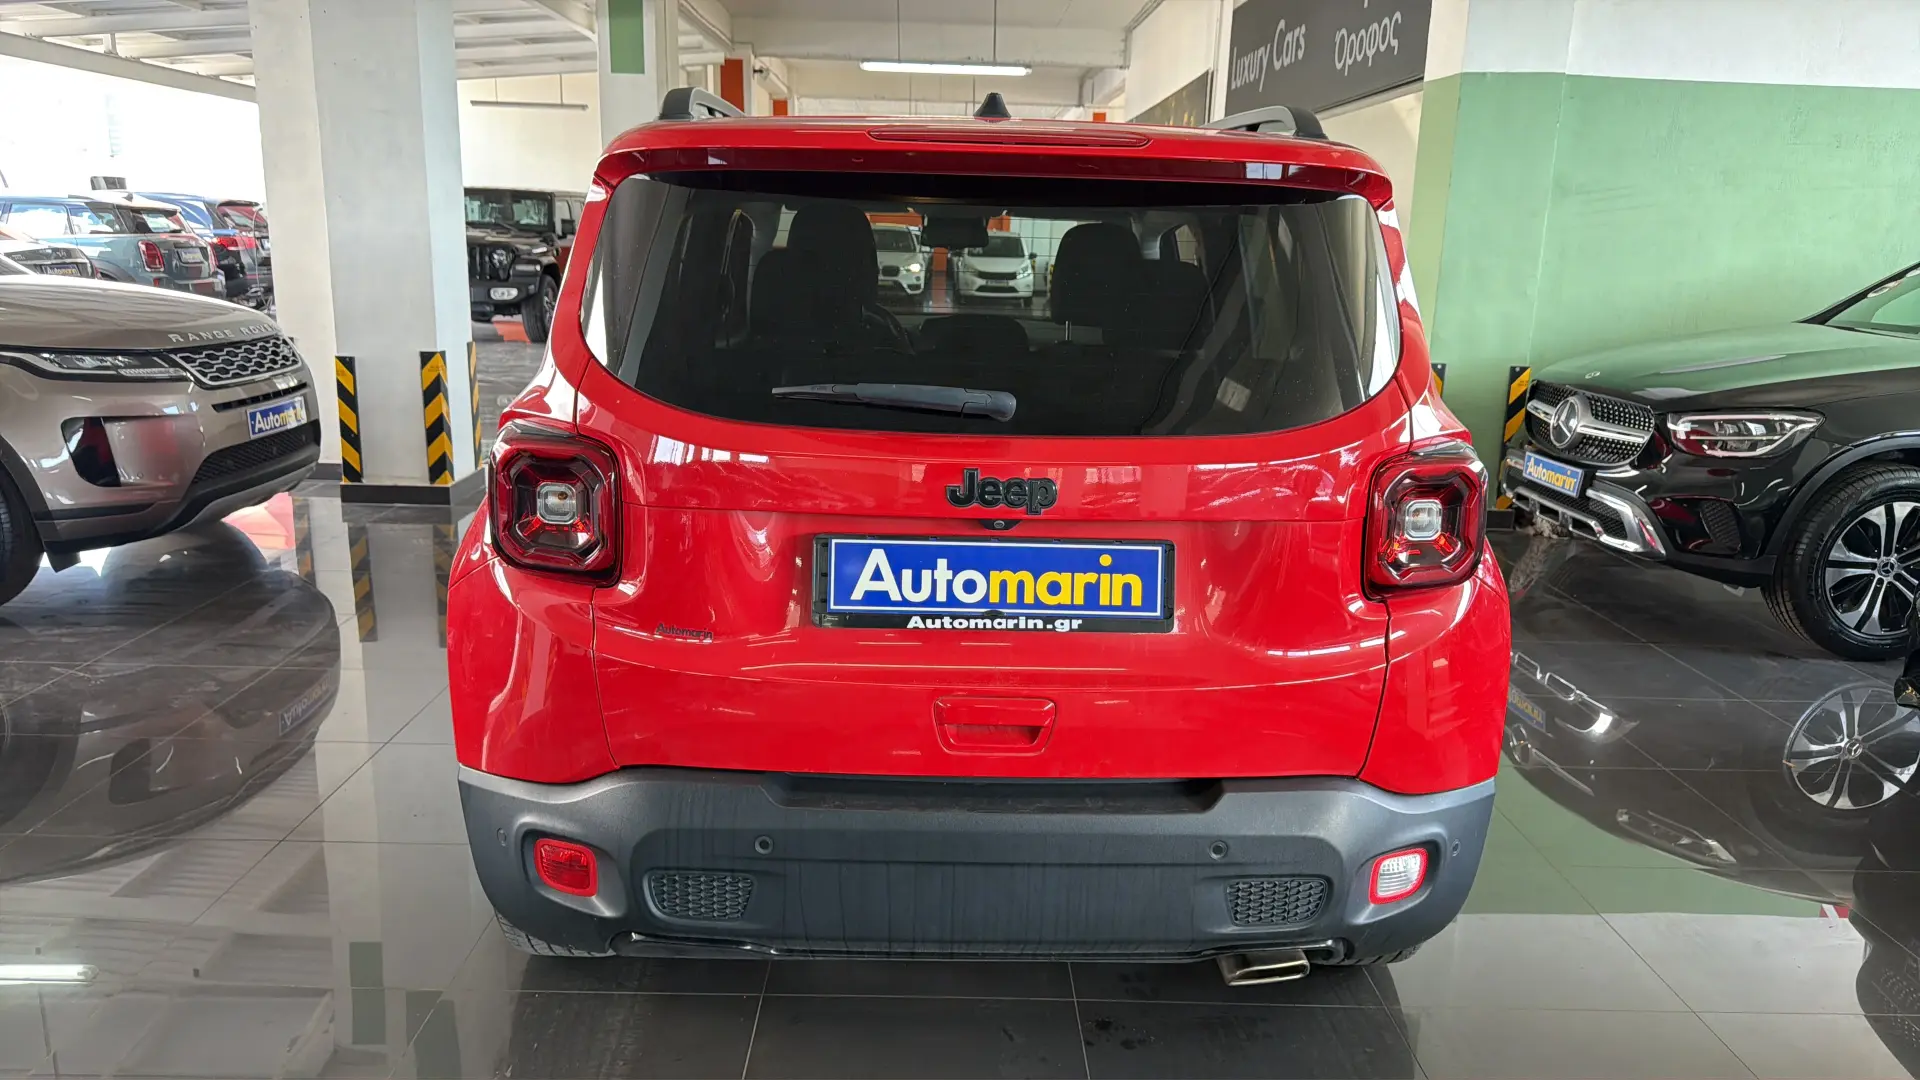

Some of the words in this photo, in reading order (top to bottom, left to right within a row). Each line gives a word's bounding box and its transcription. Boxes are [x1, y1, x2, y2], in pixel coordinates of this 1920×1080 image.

[1230, 43, 1271, 92] Luxury
[1272, 18, 1307, 71] Cars
[1334, 11, 1402, 76] Όροφος
[168, 329, 235, 343] RANGE
[945, 467, 1057, 515] Jeep
[1526, 457, 1577, 491] Automarin
[850, 548, 1142, 606] Automarin
[655, 622, 713, 640] Automarin
[906, 615, 1083, 632] Automarin.gr
